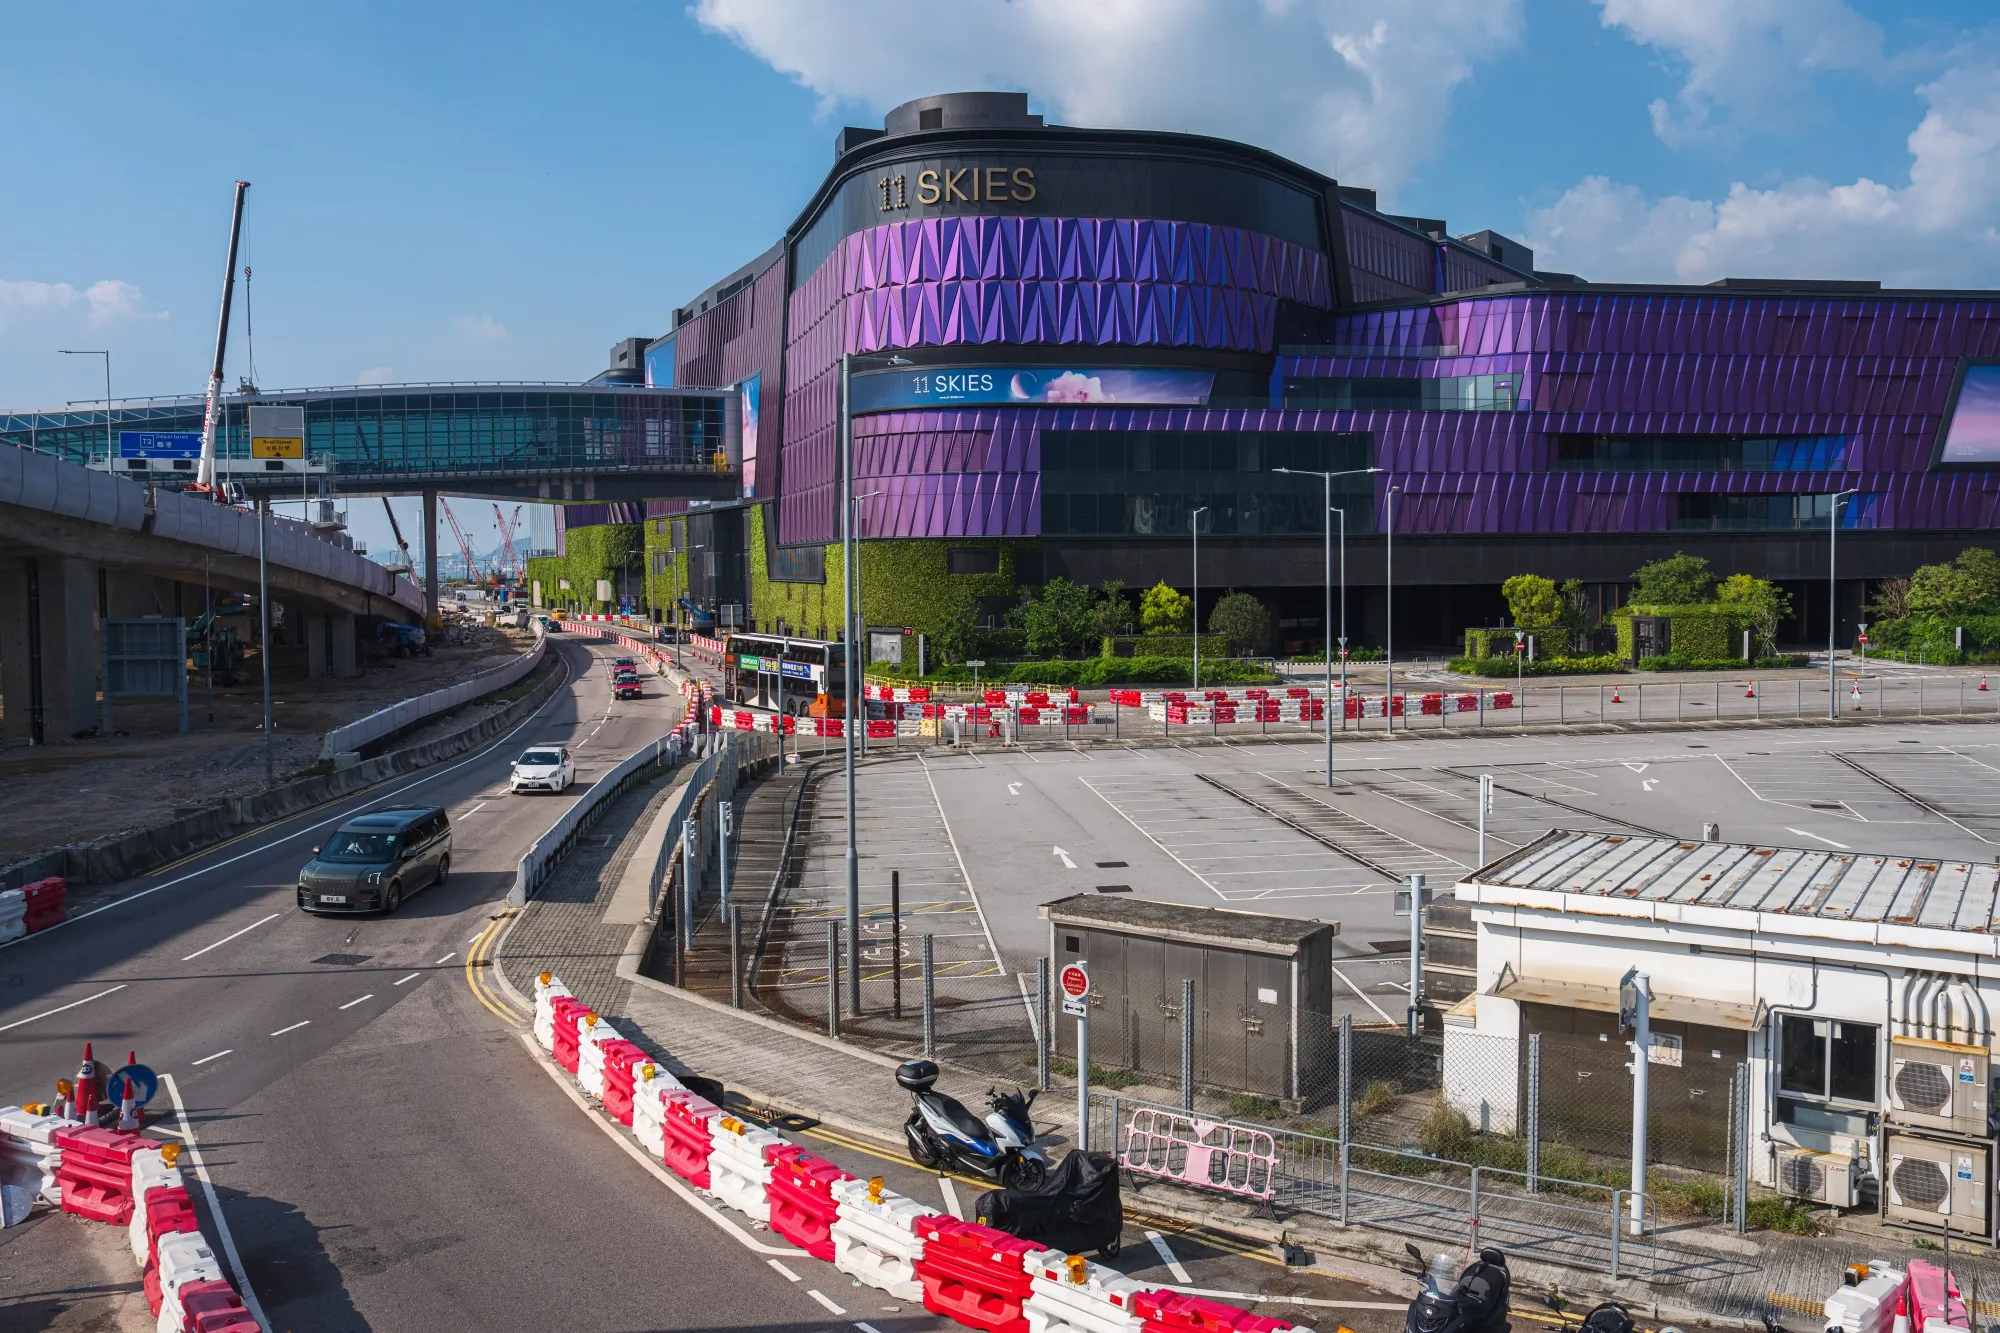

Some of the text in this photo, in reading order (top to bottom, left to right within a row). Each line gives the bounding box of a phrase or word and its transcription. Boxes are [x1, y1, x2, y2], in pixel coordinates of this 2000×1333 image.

[878, 167, 1037, 212] 11 SKIES
[913, 374, 994, 394] 11 SKIES
